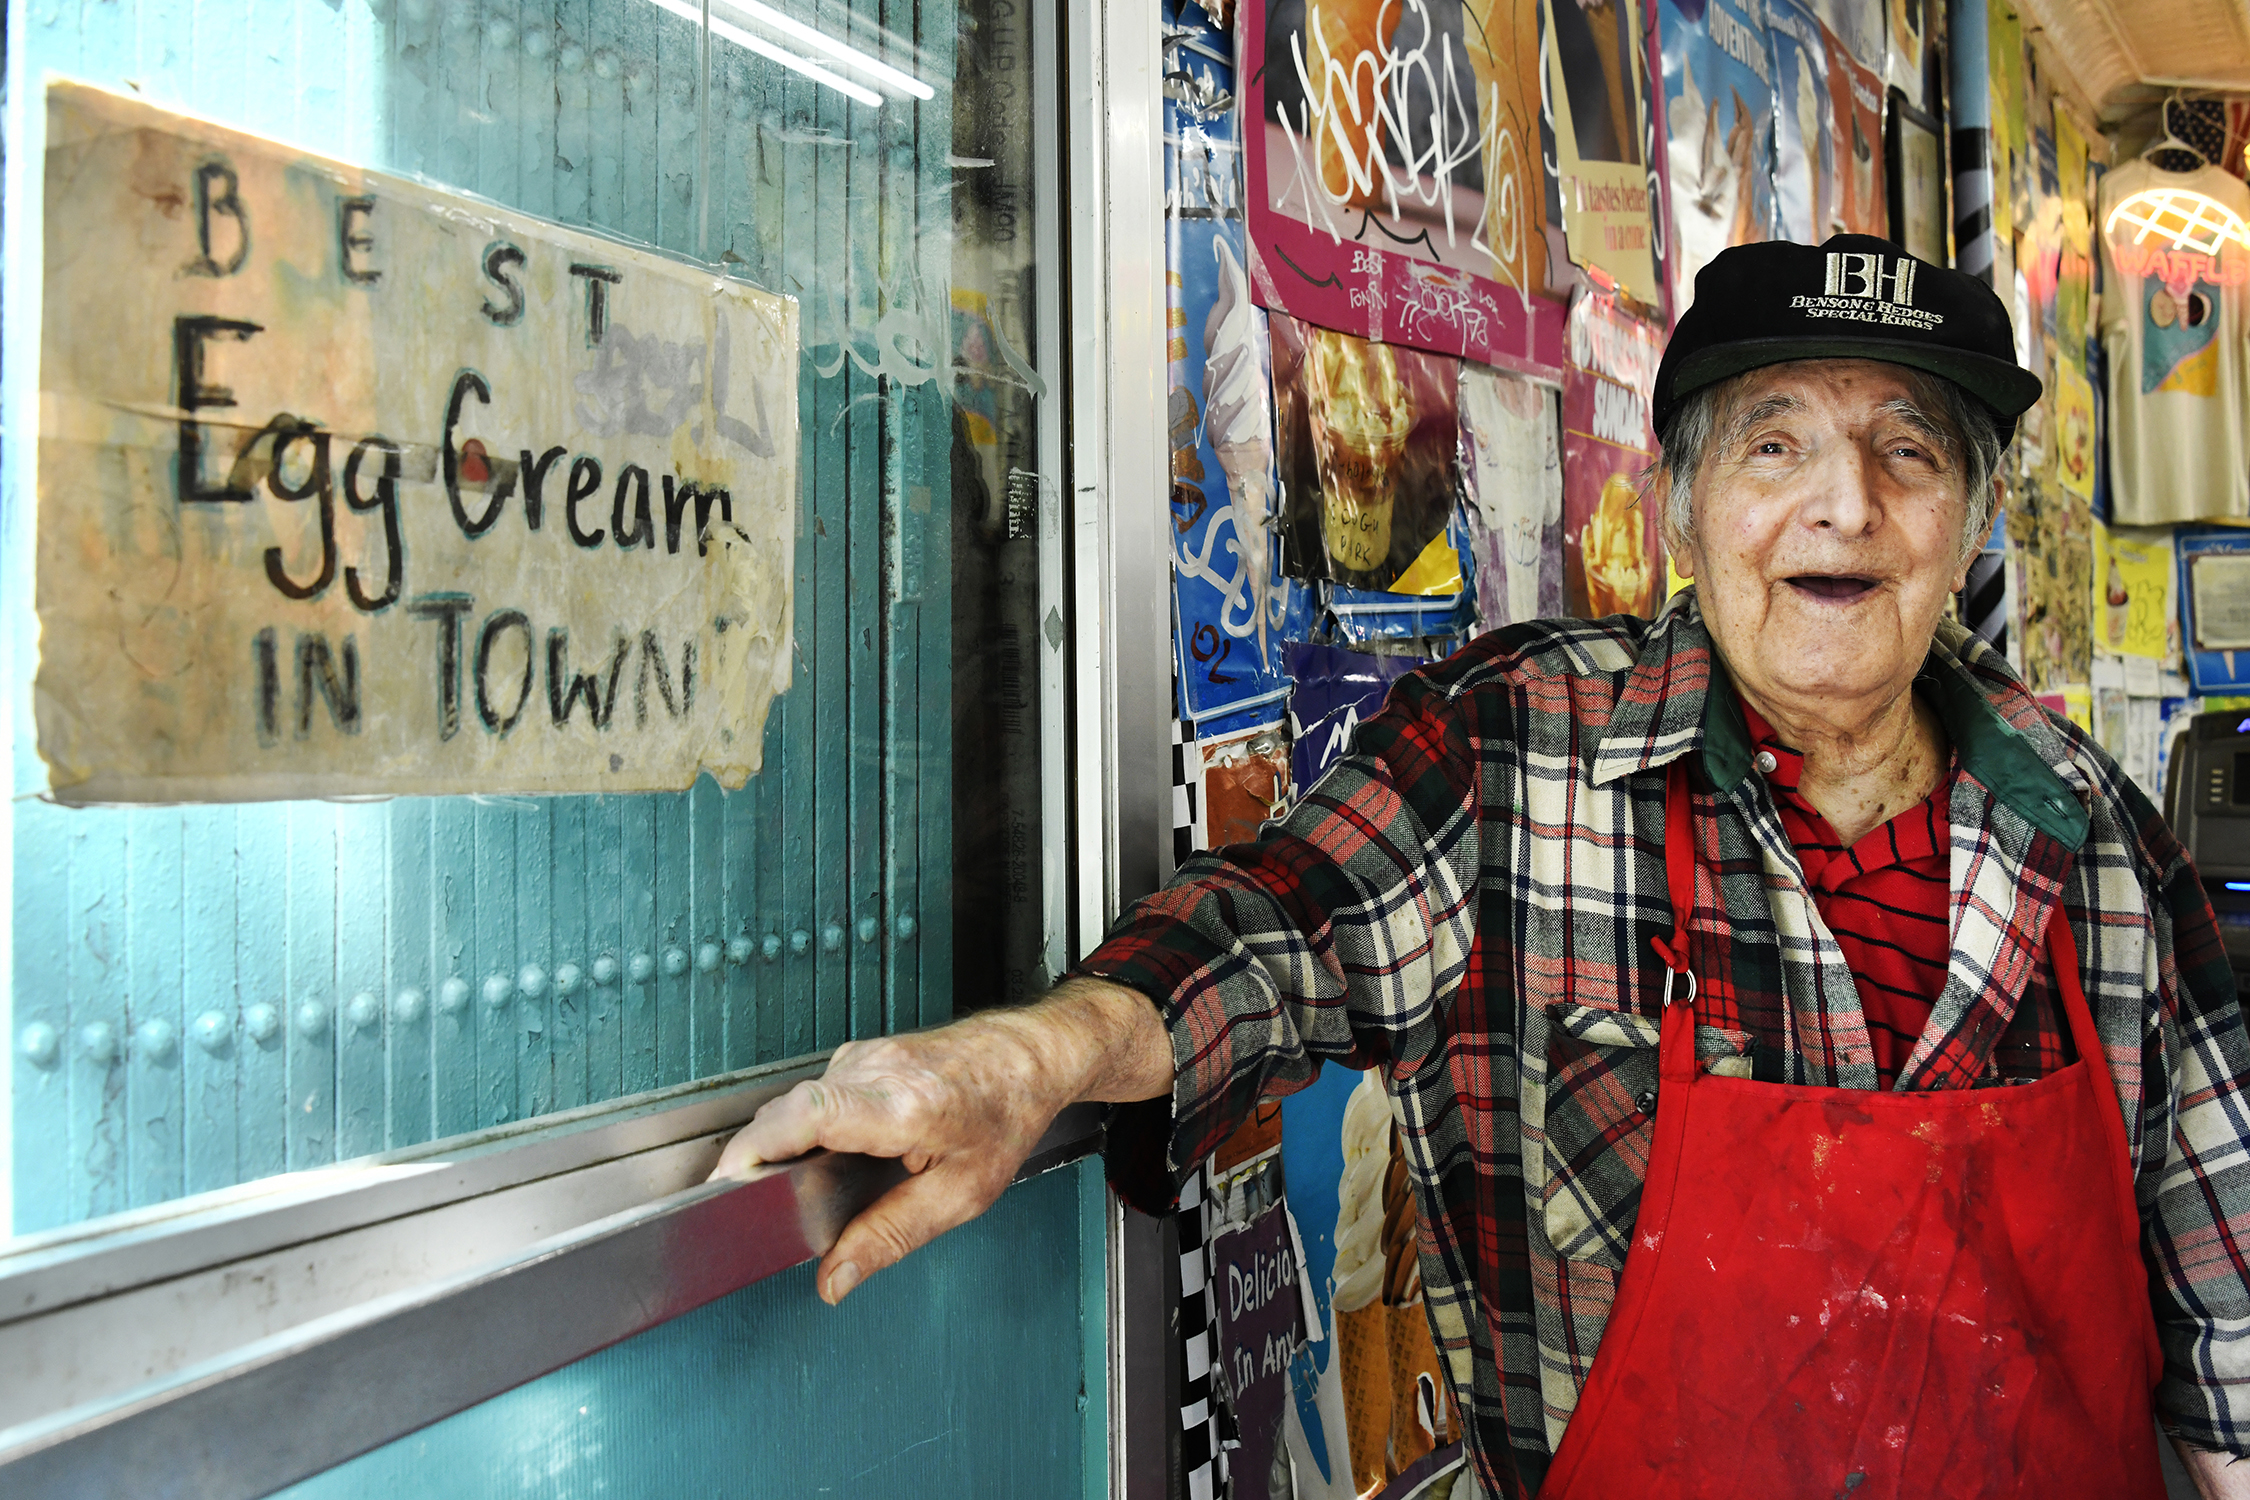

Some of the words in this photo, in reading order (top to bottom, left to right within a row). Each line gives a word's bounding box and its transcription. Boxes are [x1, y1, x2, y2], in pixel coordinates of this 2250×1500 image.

[1588, 178, 1620, 213] tastes
[1620, 176, 1646, 213] better
[173, 162, 623, 347] BEST
[1603, 215, 1618, 251] in
[1618, 226, 1624, 250] a
[1625, 225, 1645, 250] cone
[1824, 252, 1917, 306] BH
[2115, 244, 2247, 286] WAFFLE
[1789, 295, 1862, 310] BENSON
[1862, 301, 1875, 311] &
[1876, 300, 1944, 324] HEDGES
[1805, 307, 1878, 323] SPECIAL
[1880, 313, 1934, 330] KINGS
[171, 314, 406, 613] Egg
[441, 368, 752, 557] Cream
[253, 626, 362, 745] IN
[1234, 1346, 1254, 1400] In
[1262, 1321, 1296, 1378] Any
